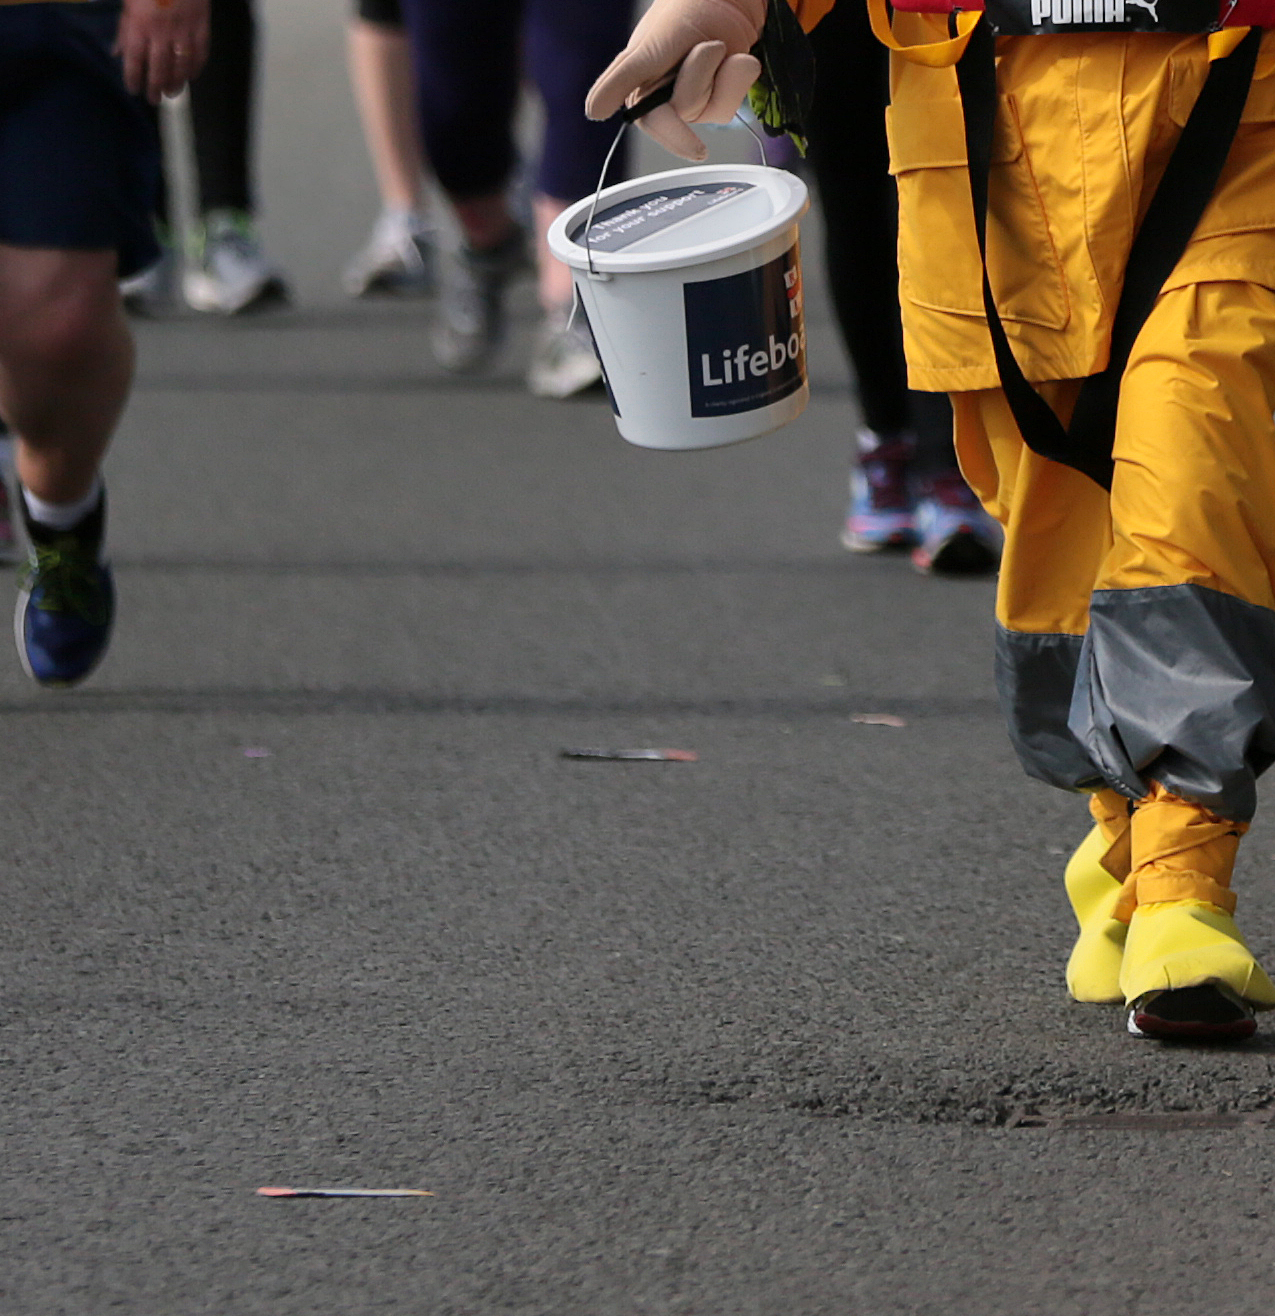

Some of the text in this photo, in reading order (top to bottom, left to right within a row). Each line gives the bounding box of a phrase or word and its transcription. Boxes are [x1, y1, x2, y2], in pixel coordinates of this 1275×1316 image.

[591, 195, 669, 230] Thank you
[612, 217, 646, 233] your
[648, 189, 705, 217] support
